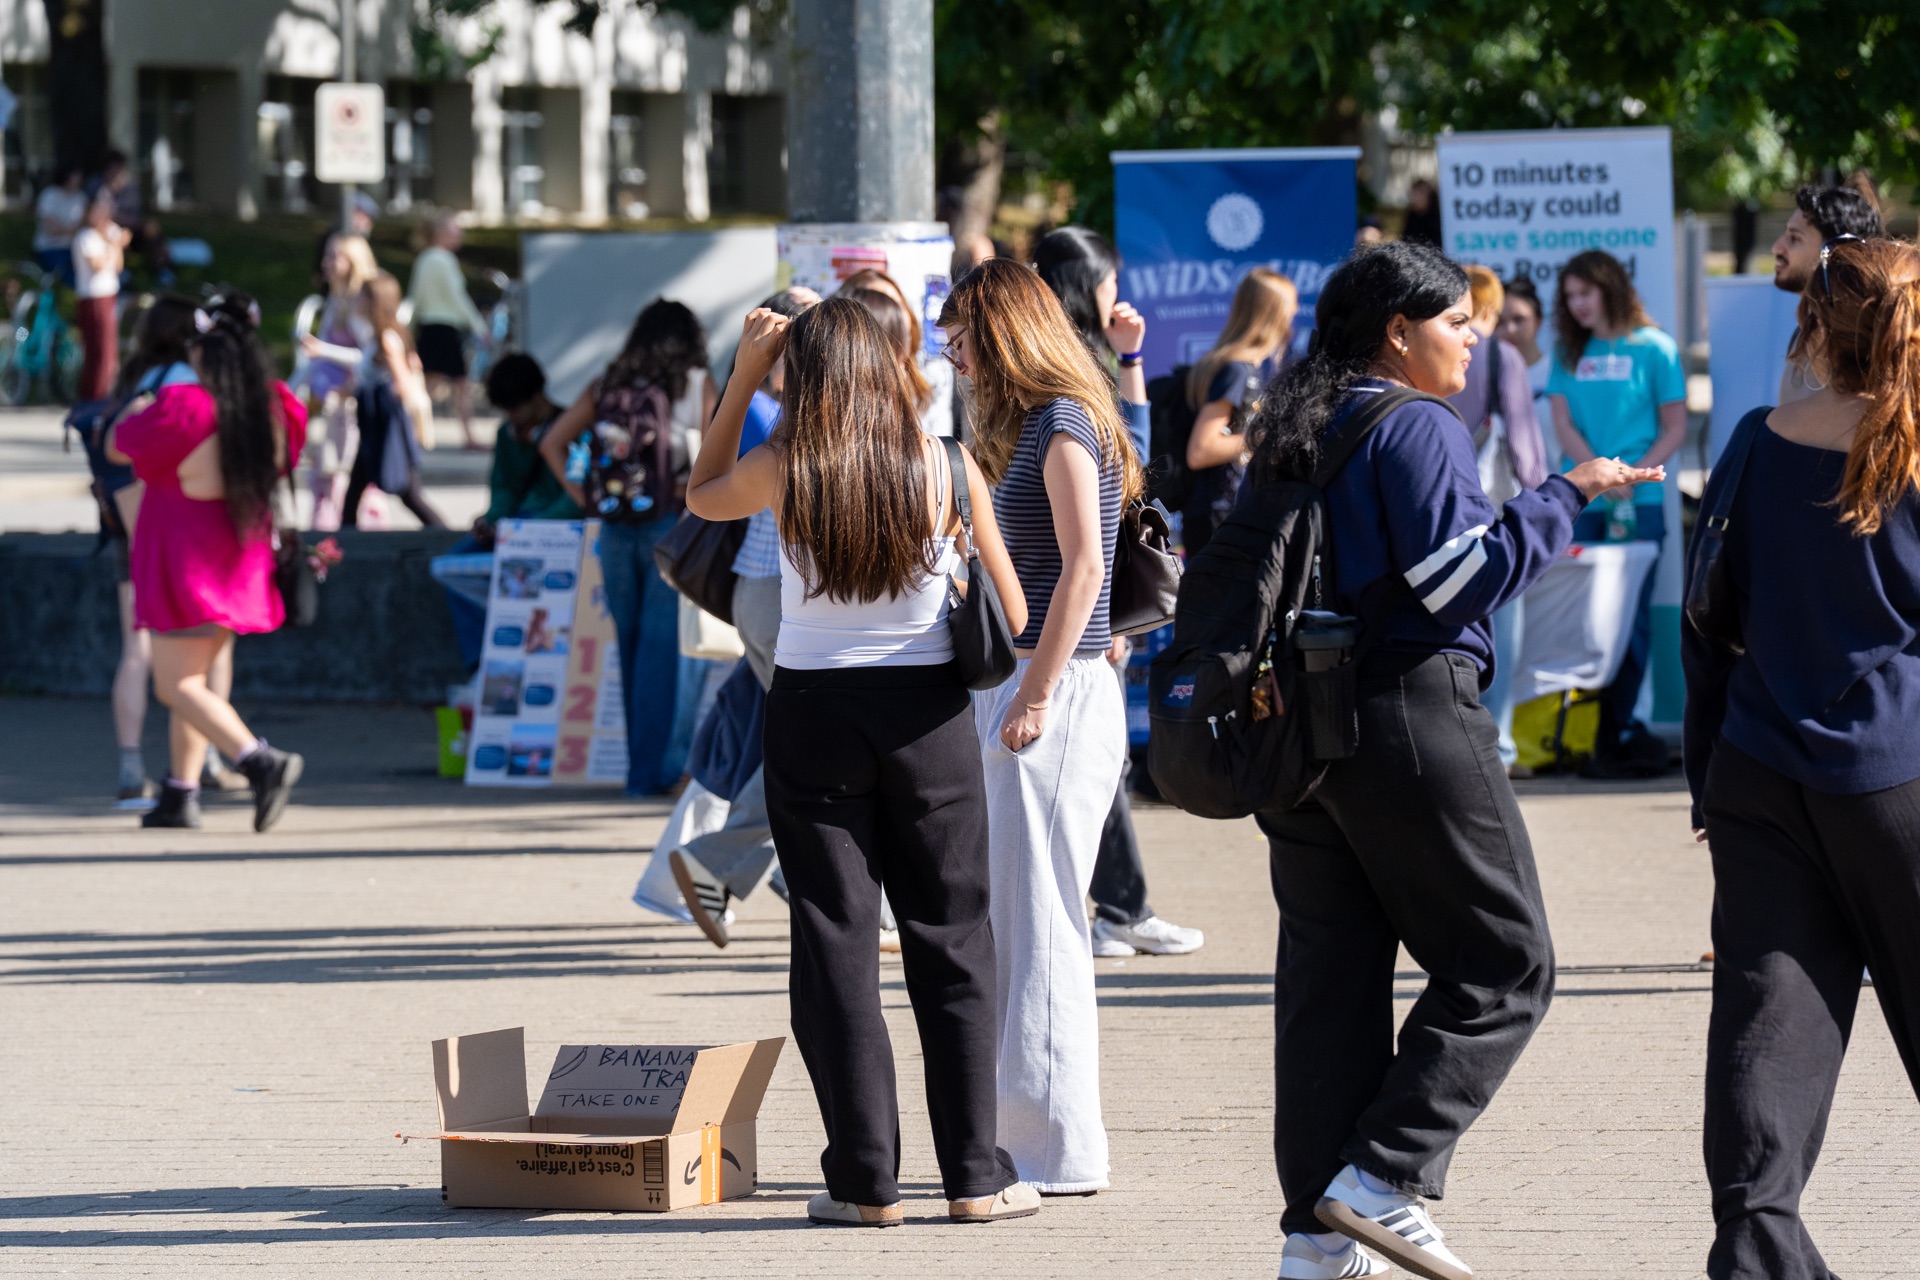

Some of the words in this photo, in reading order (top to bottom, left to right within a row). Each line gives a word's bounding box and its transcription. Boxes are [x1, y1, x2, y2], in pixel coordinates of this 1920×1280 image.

[1451, 163, 1484, 187] 10
[1492, 160, 1609, 186] minutes
[1454, 194, 1536, 223] today
[1544, 190, 1621, 217] could
[1454, 230, 1519, 250] save
[1527, 227, 1657, 249] someone
[578, 636, 597, 674] 1
[565, 684, 597, 721] 2
[557, 735, 590, 774] 3
[557, 1093, 615, 1107] TAKE
[623, 1094, 660, 1106] ONE
[536, 1143, 572, 1158] vrai.)
[575, 1145, 588, 1158] de
[595, 1143, 634, 1160] (Pour
[578, 1159, 594, 1171] ça
